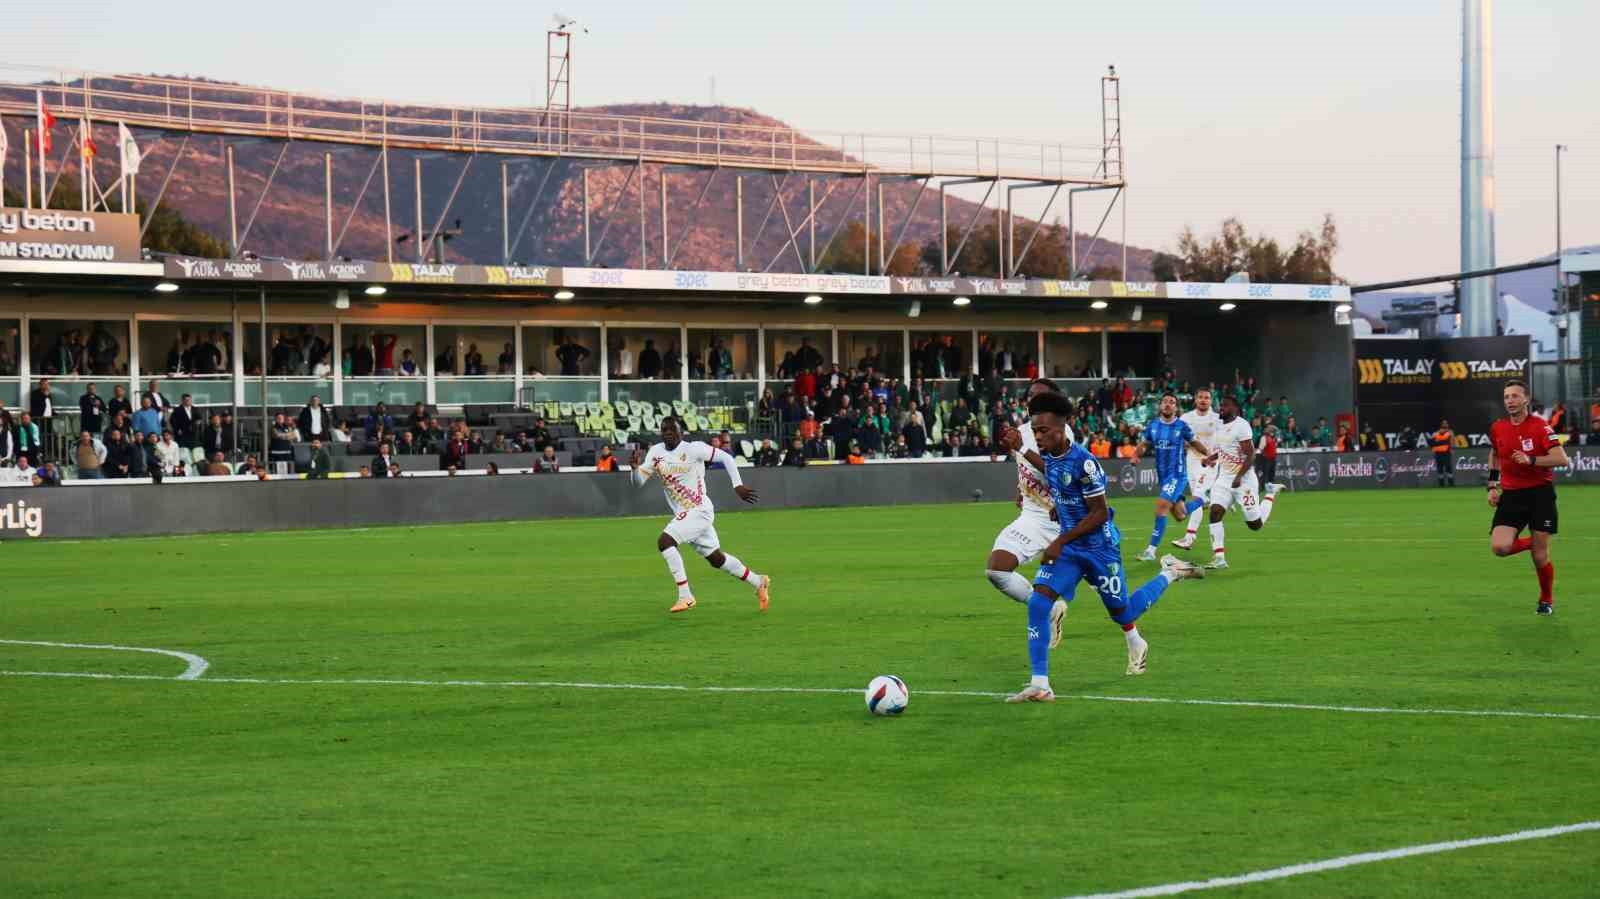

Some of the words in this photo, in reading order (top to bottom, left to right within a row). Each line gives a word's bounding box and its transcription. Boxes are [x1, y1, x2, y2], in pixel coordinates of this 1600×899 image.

[21, 210, 96, 232] beton
[19, 242, 115, 260] STADYUMU
[411, 264, 456, 276] TALAY
[506, 267, 549, 278] TALAY
[1383, 359, 1434, 375] TALAY
[1467, 359, 1528, 373] TALAY
[1243, 495, 1256, 506] 23
[1097, 575, 1121, 594] 20
